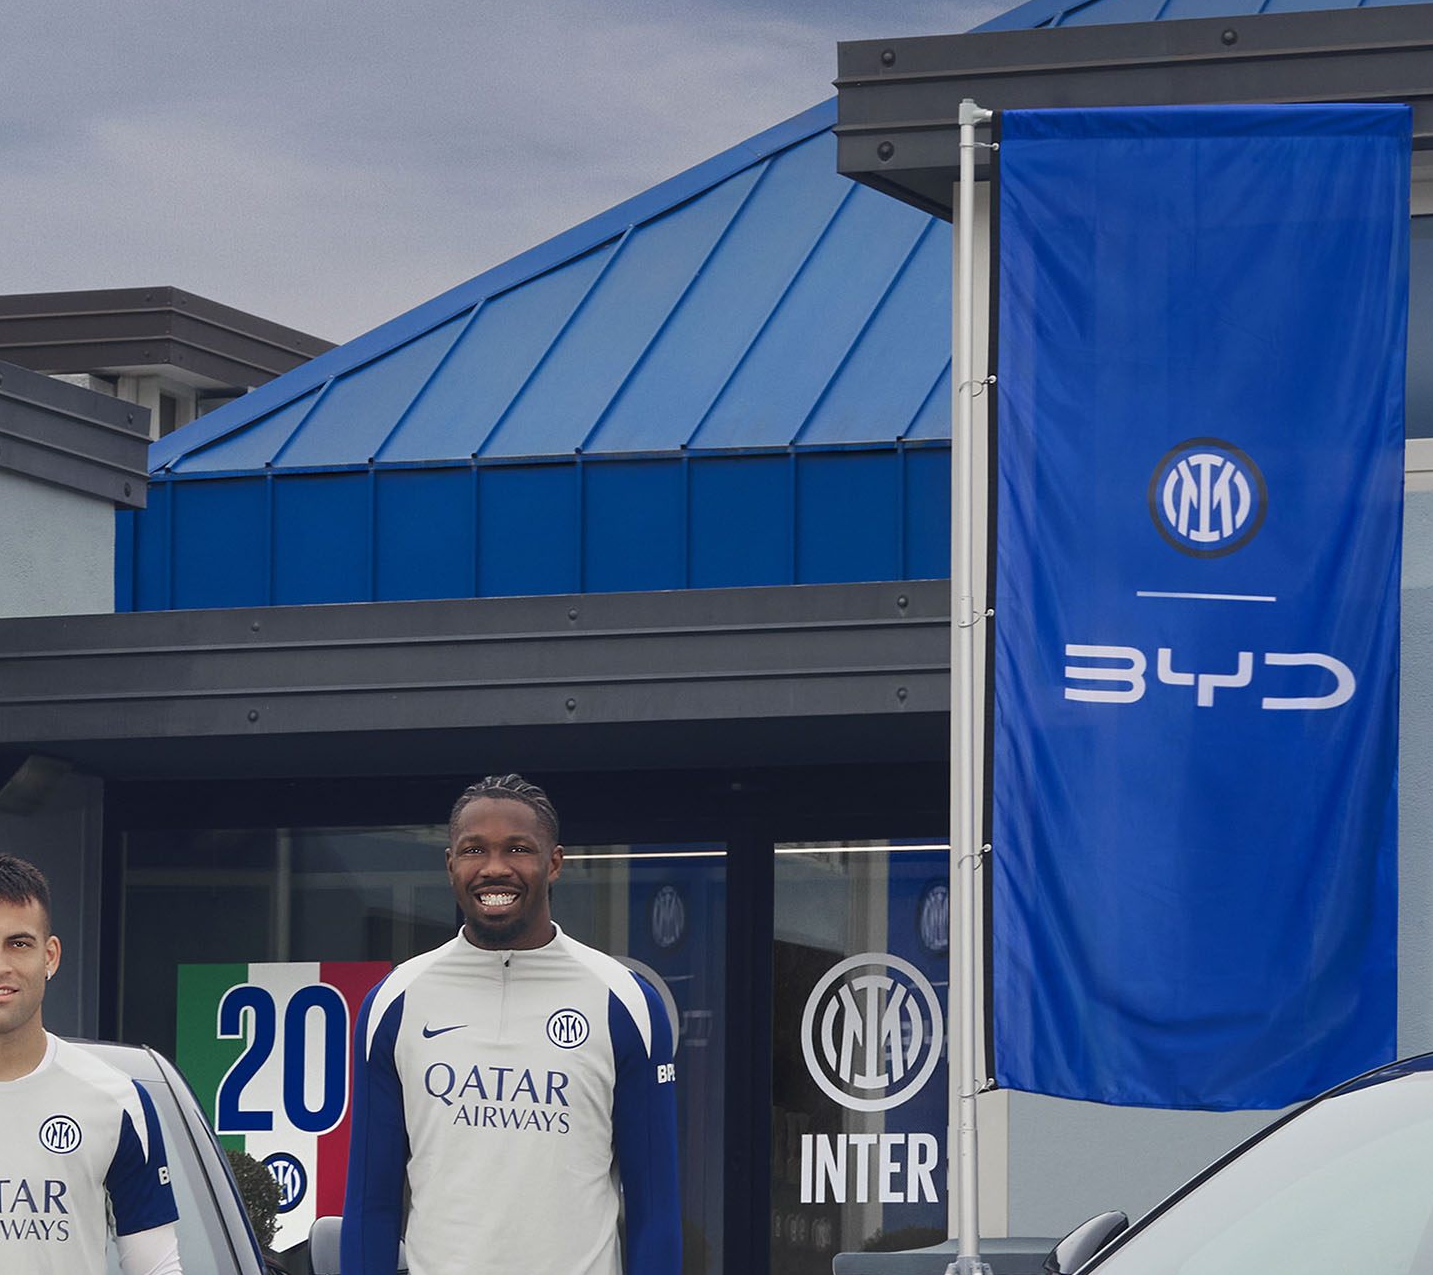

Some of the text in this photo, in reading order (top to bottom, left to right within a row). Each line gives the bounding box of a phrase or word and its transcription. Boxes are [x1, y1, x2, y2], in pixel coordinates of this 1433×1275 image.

[1065, 644, 1356, 709] BYD
[217, 984, 349, 1134] 20
[425, 1063, 569, 1107] QATAR
[454, 1104, 570, 1134] AIRWAYS
[801, 1133, 939, 1204] INTER
